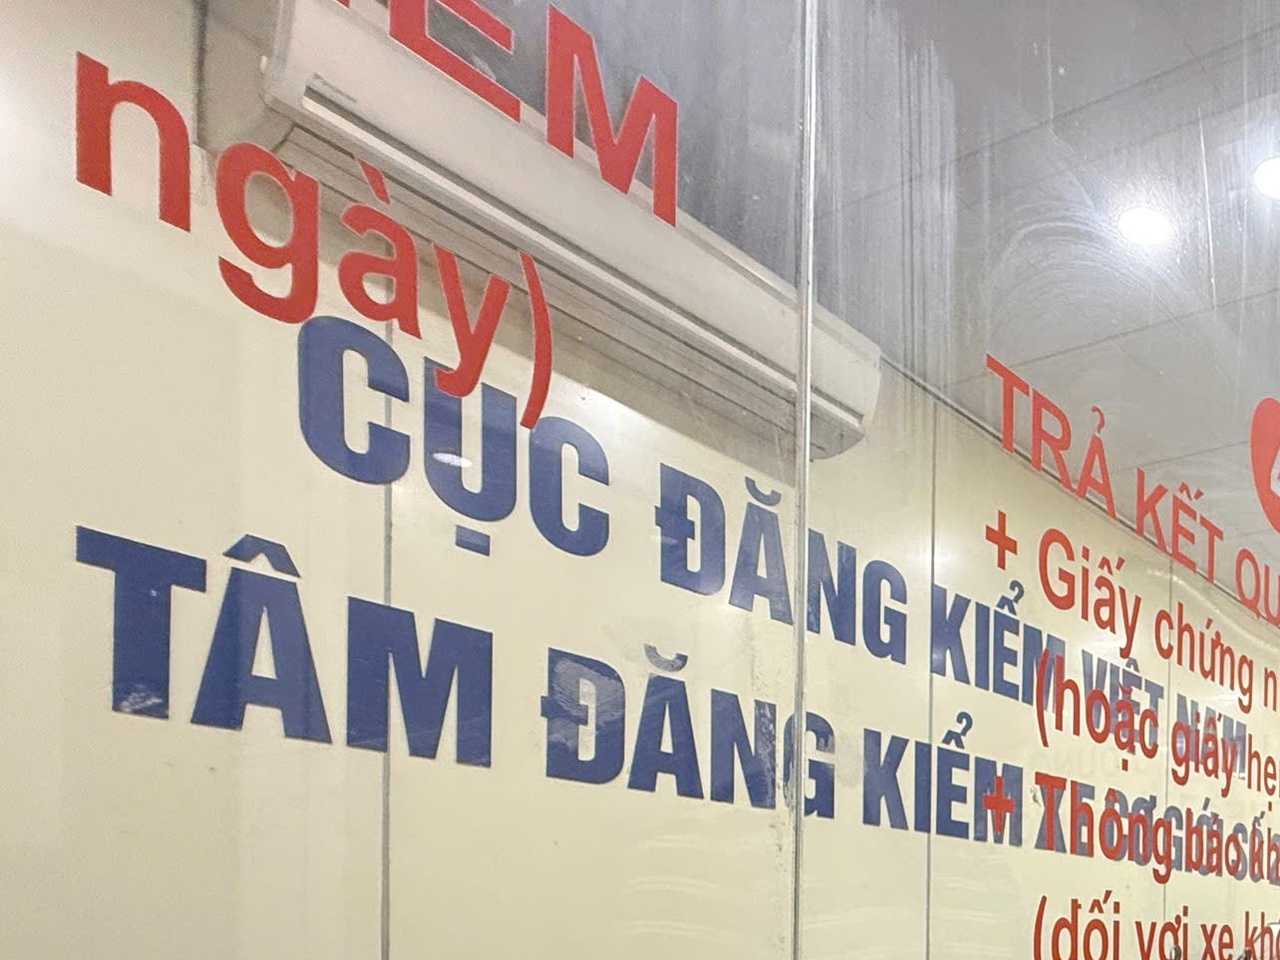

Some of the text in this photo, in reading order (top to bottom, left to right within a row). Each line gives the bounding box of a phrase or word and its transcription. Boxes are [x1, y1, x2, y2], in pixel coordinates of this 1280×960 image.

[75, 51, 554, 429] ngày)
[297, 315, 610, 557] CỤC
[655, 463, 908, 665] ĐĂNG
[930, 580, 1066, 714] KIỂM
[986, 353, 1117, 520] TRẢ
[1136, 467, 1224, 584] KẾT
[75, 524, 494, 768] TÂM
[540, 643, 835, 820] ĐĂNG
[863, 711, 1023, 847] KIỂM
[1036, 648, 1159, 772] (hoặc
[1171, 711, 1238, 798] giấy
[1038, 528, 1142, 659] Giấy
[1154, 602, 1253, 714] chứng
[1034, 771, 1172, 884] Thông
[1185, 807, 1242, 877] báo
